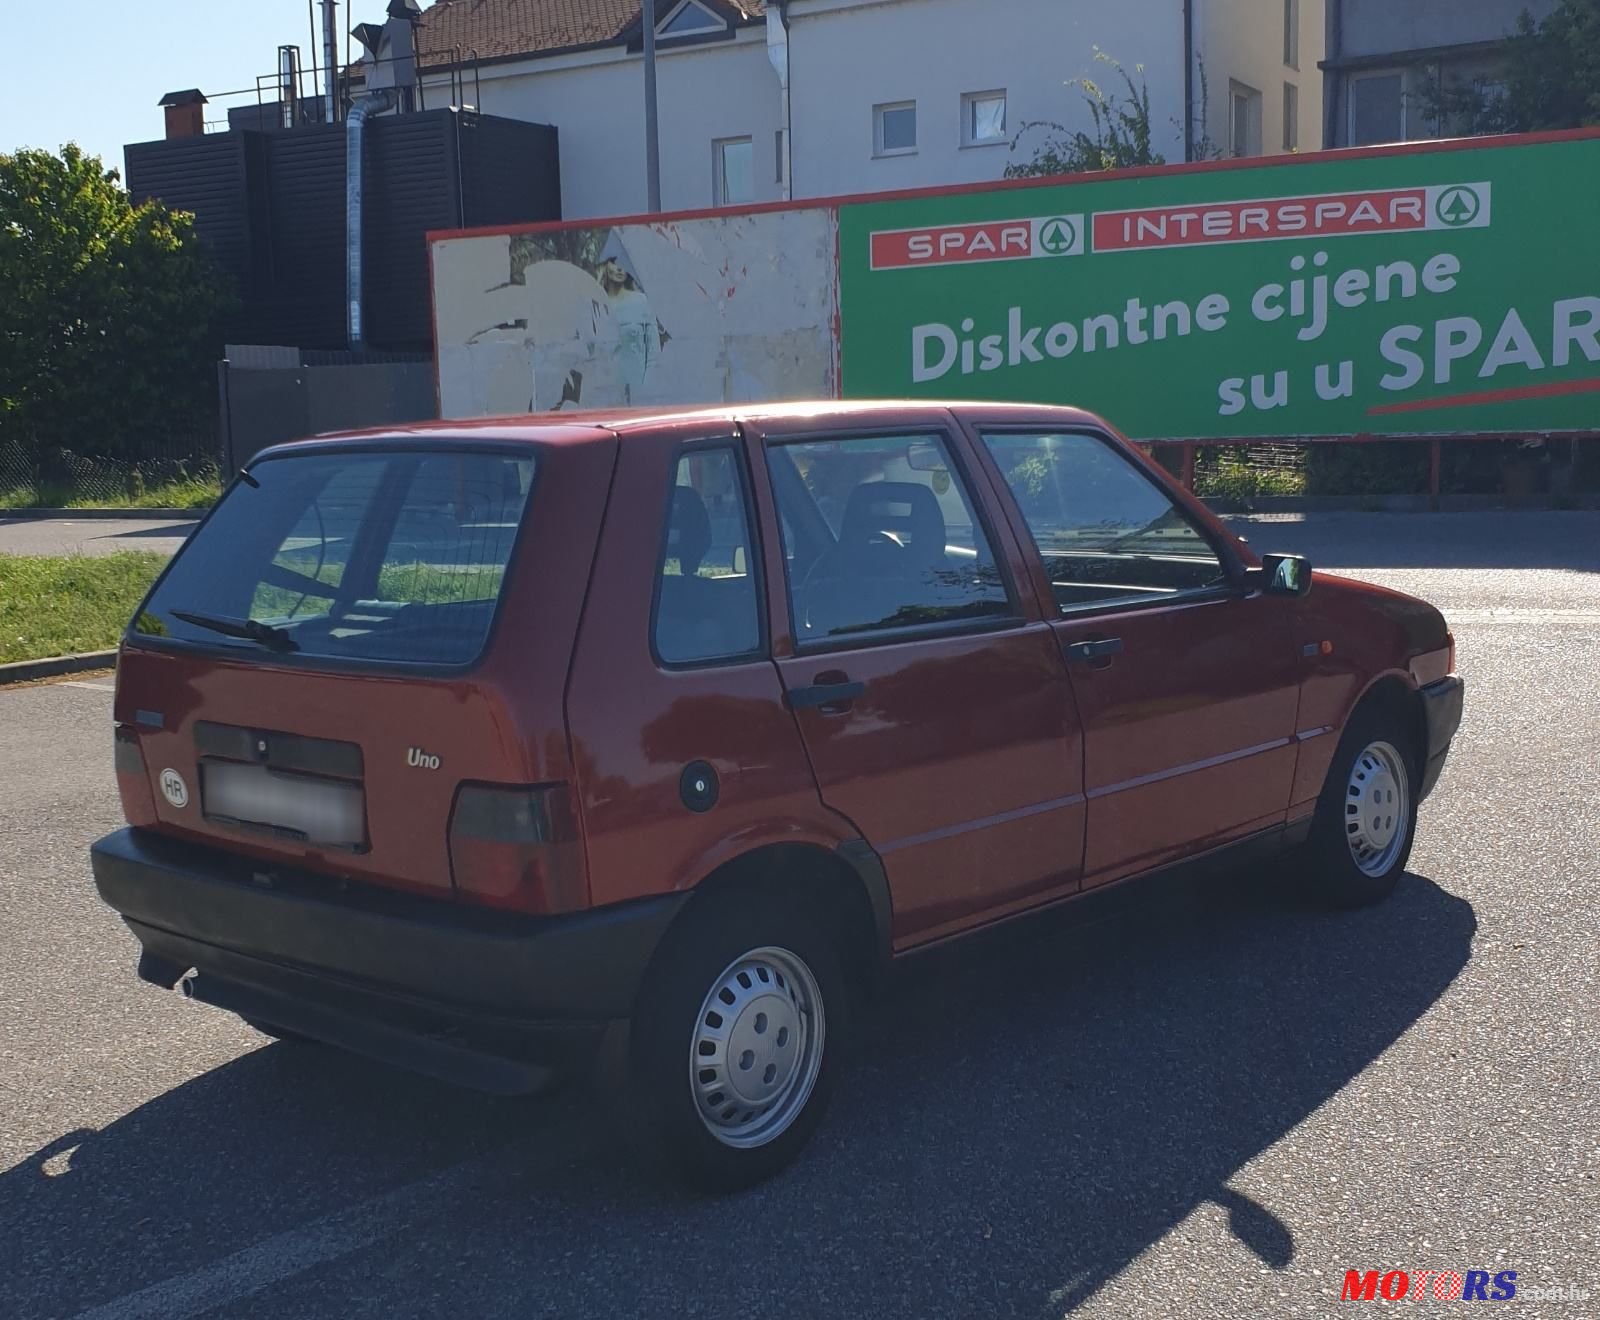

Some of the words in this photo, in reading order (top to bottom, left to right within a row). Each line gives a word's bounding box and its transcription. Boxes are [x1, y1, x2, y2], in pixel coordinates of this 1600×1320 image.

[1123, 196, 1422, 243] INTERSPAR
[908, 227, 1028, 259] SPAR
[912, 293, 1231, 383] Diskontne
[1251, 251, 1462, 341] cijene
[1218, 369, 1289, 416] su
[1315, 360, 1353, 400] u
[1379, 296, 1600, 390] SPAR
[407, 748, 440, 769] Uno
[164, 775, 183, 799] HR
